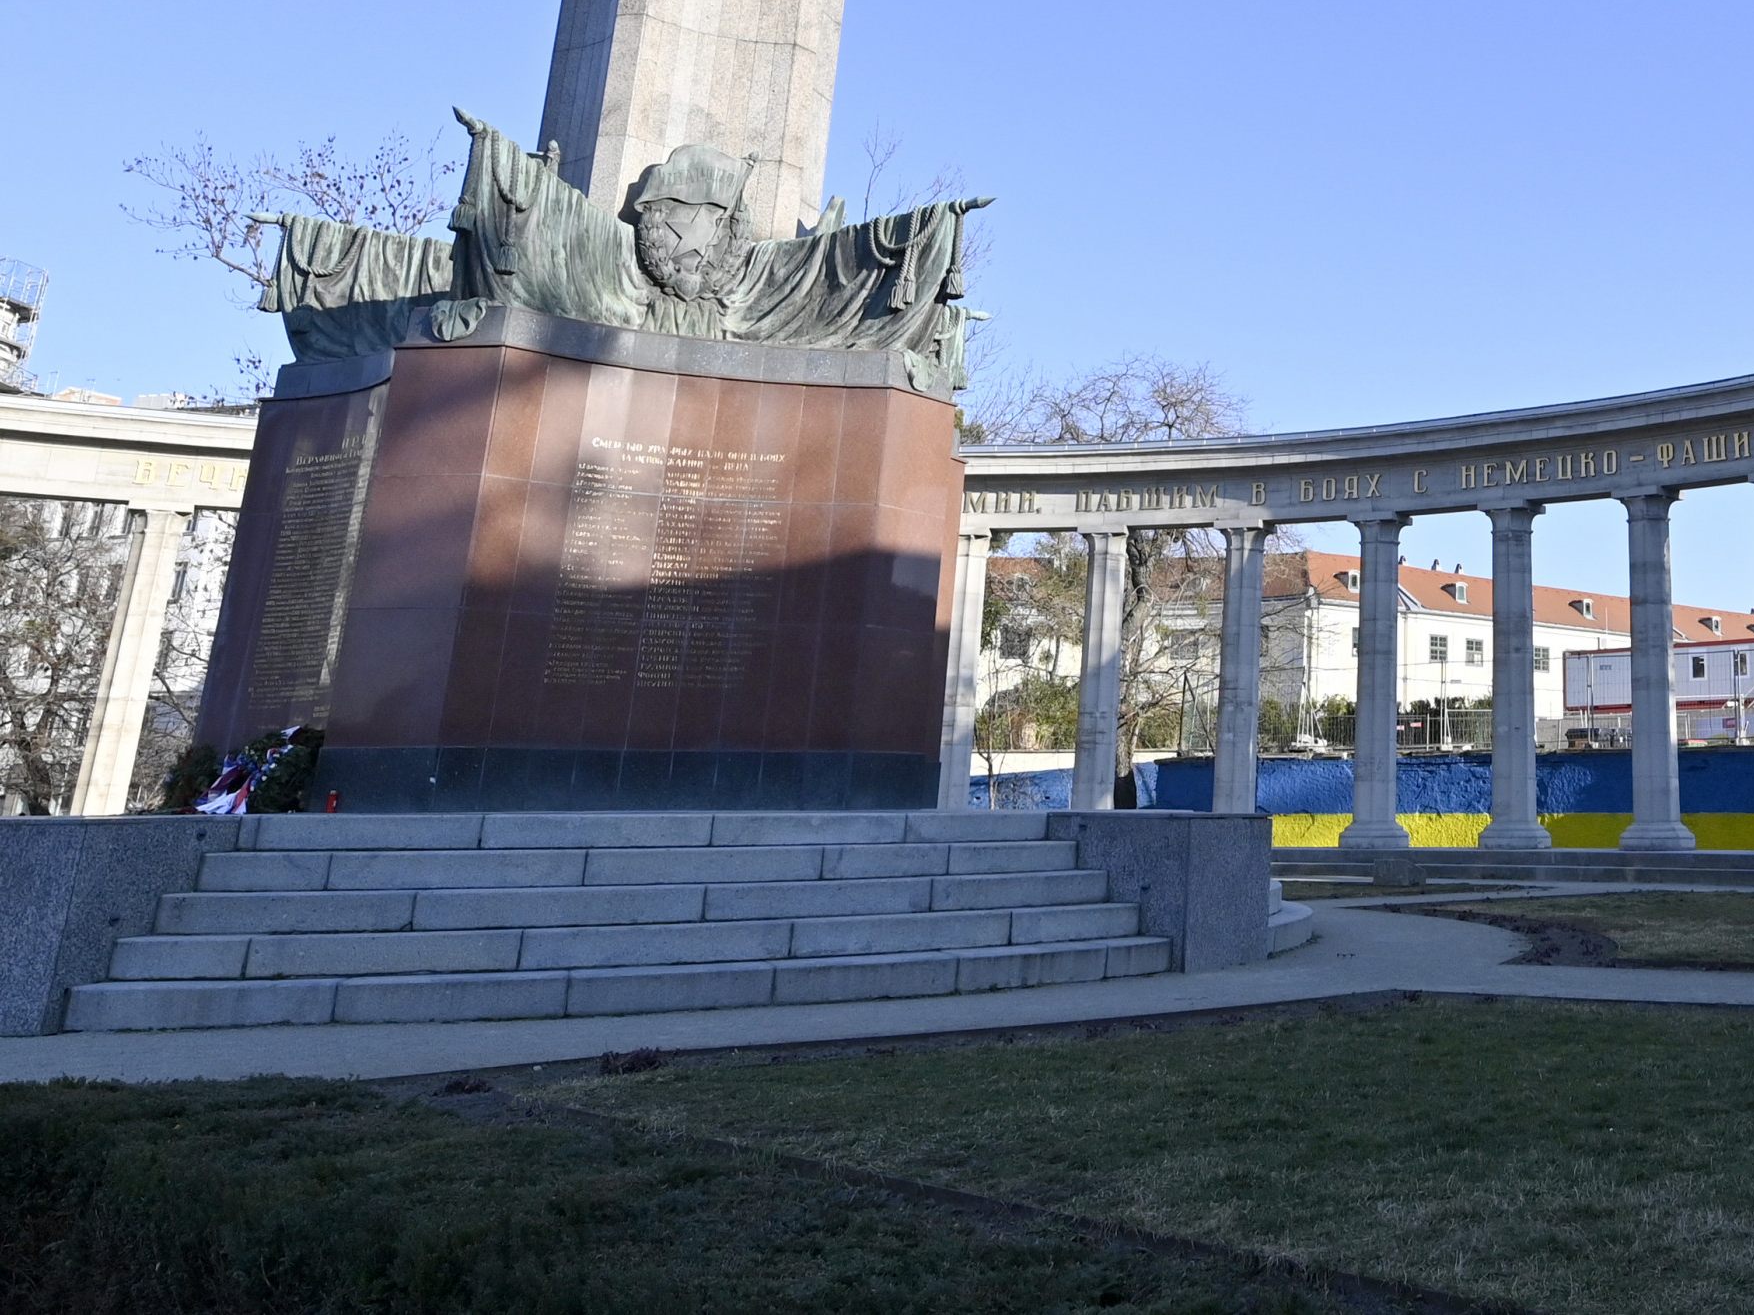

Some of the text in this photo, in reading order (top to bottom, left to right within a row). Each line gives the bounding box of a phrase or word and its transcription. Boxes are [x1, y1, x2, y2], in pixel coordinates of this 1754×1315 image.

[1075, 485, 1219, 513] ПАВШИМ
[1250, 482, 1267, 506] В
[1300, 473, 1383, 502] БОЯХ
[1413, 469, 1429, 494] С
